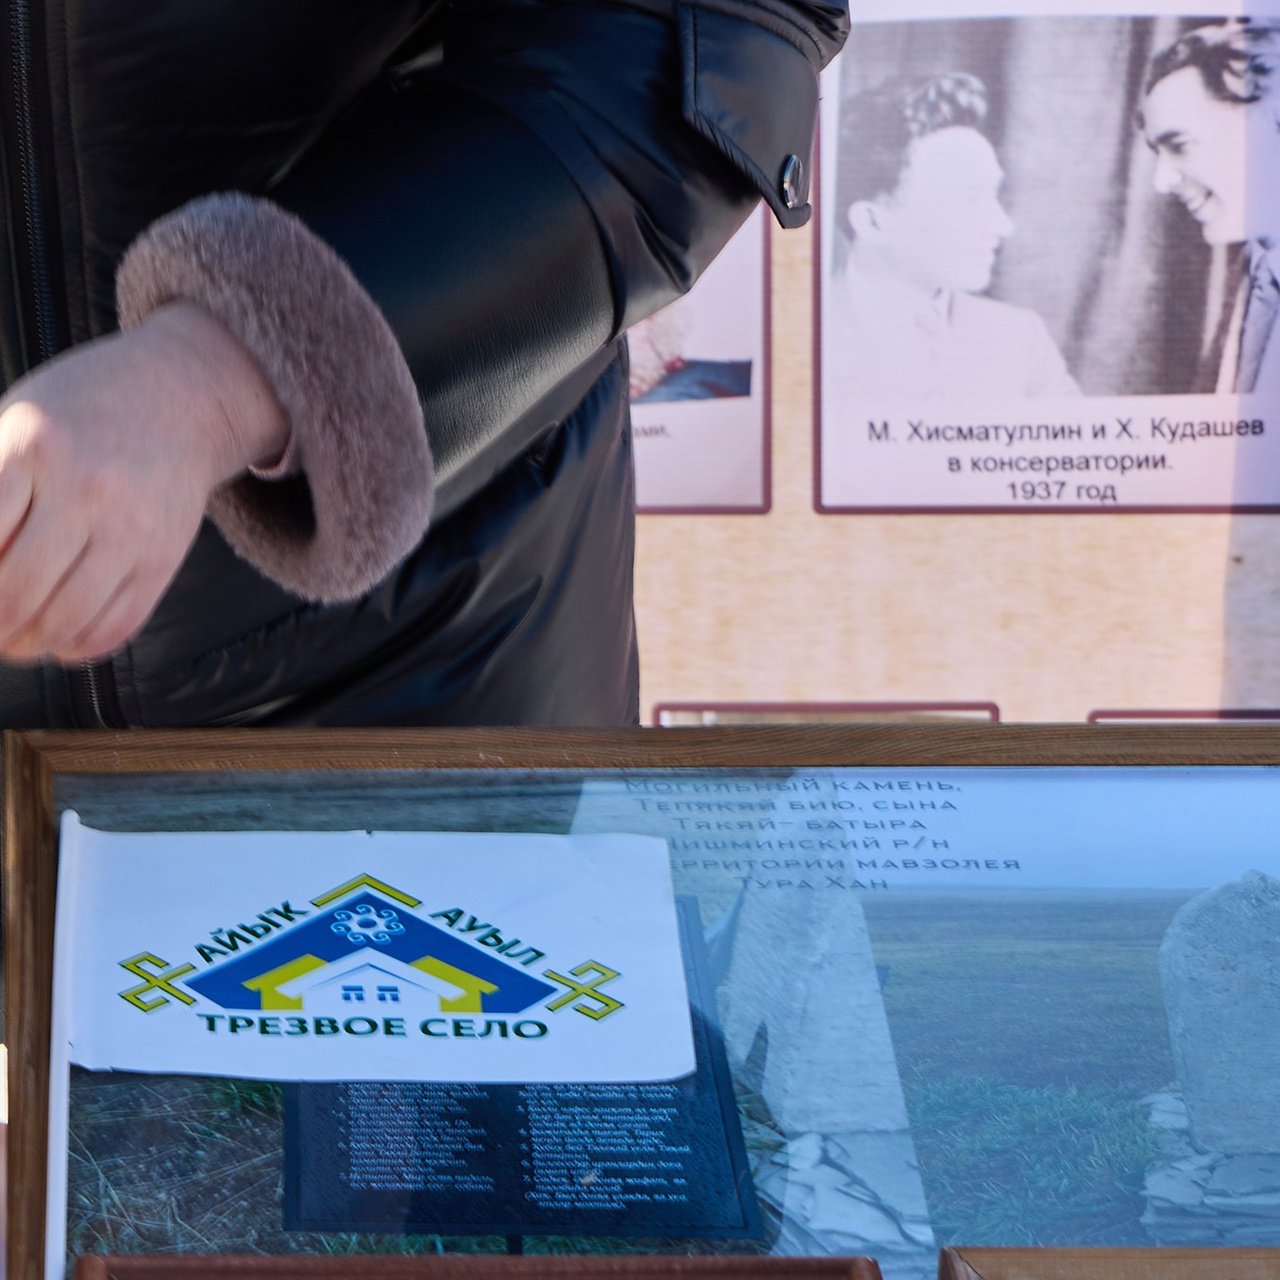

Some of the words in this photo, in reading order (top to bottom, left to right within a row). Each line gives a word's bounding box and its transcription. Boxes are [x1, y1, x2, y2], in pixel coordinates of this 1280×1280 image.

[867, 421, 898, 443] М.
[906, 420, 1083, 447] Хисматуллин
[1091, 423, 1107, 440] и
[1114, 417, 1140, 441] Х.
[1150, 417, 1266, 443] Кудашев
[948, 456, 962, 472] в
[970, 452, 1174, 477] консерватории.
[1007, 480, 1067, 502] 1937
[1076, 483, 1118, 503] год
[428, 907, 546, 967] АУЫЛ
[196, 1013, 407, 1038] ТРЕЗВОЕ
[418, 1016, 550, 1040] СЕЛО
